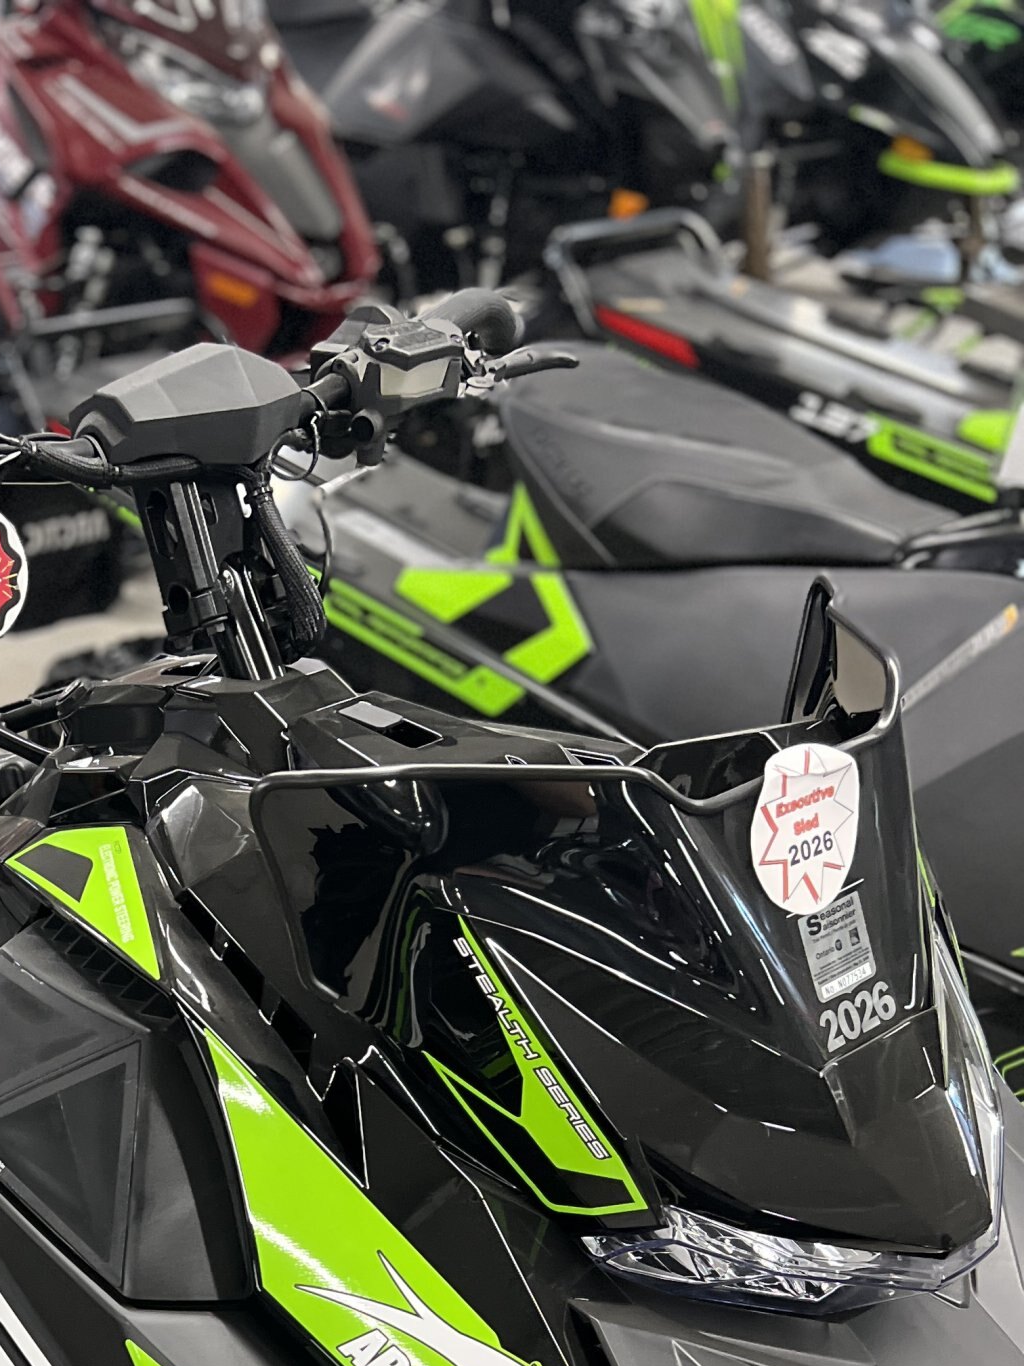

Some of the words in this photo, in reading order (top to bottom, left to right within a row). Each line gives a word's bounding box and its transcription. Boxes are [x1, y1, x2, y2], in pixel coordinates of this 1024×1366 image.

[776, 786, 834, 818] Executive
[793, 812, 820, 836] Sled
[788, 830, 833, 866] 2026
[806, 896, 854, 936] Seasonal
[820, 981, 896, 1053] 2026
[452, 936, 540, 1062] STEALTH
[533, 1066, 612, 1161] SERIES
